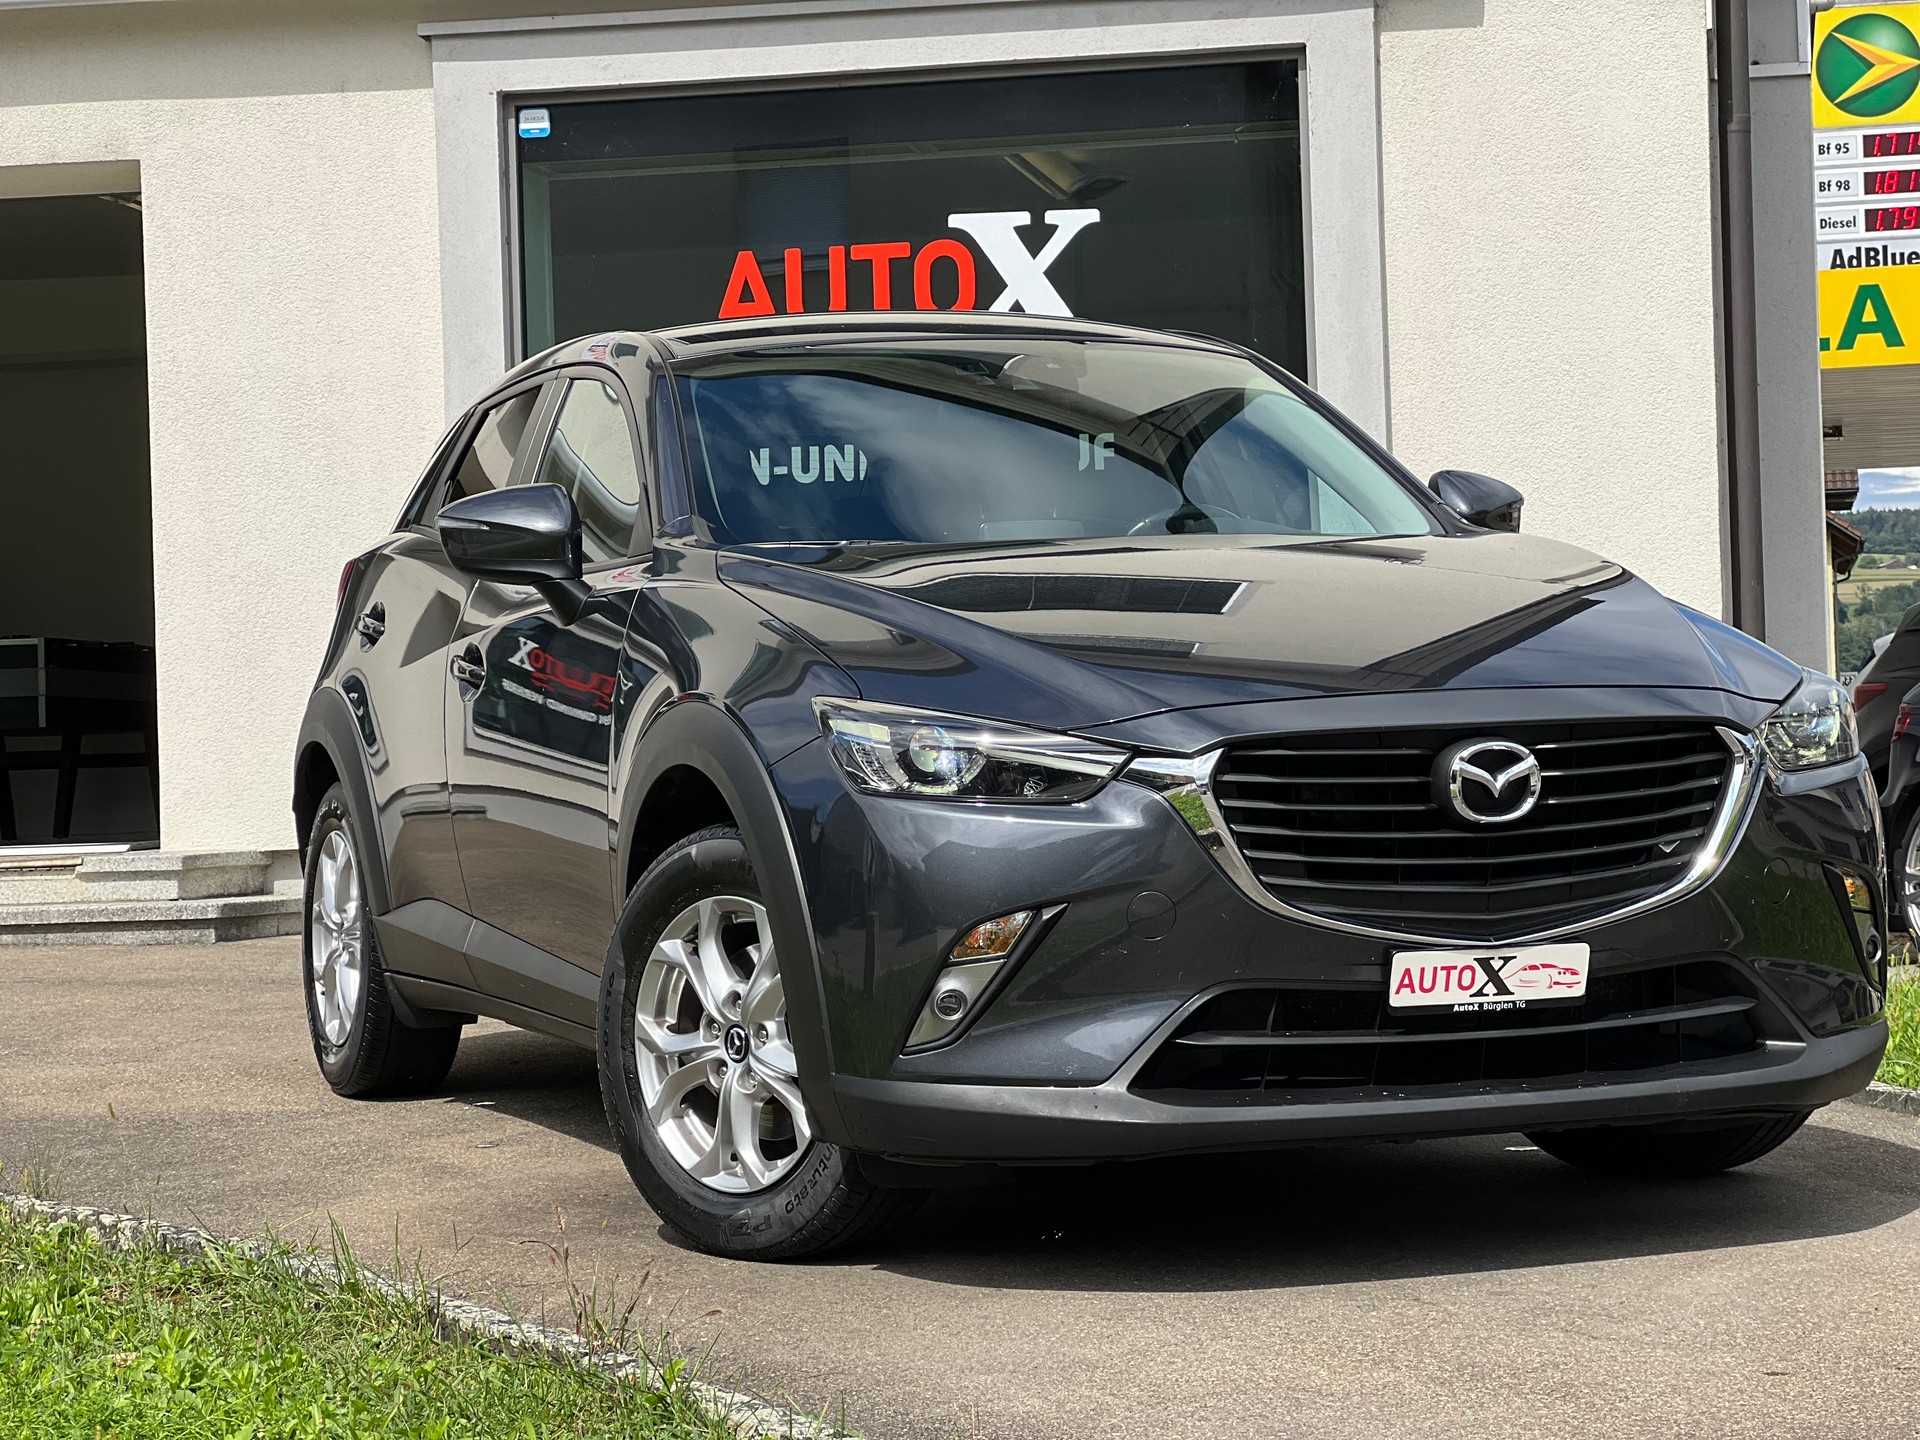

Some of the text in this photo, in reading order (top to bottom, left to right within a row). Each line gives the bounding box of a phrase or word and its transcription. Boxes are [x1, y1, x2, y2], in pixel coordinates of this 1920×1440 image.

[1818, 133, 1920, 156] Bf 95 1.71
[1819, 180, 1832, 192] Bf
[1835, 180, 1850, 191] 98
[1819, 215, 1856, 229] Diesel
[1830, 244, 1920, 270] AdBlue
[1394, 955, 1517, 998] AUTOX
[1453, 1000, 1526, 1012] AutoX Bürglen TG
